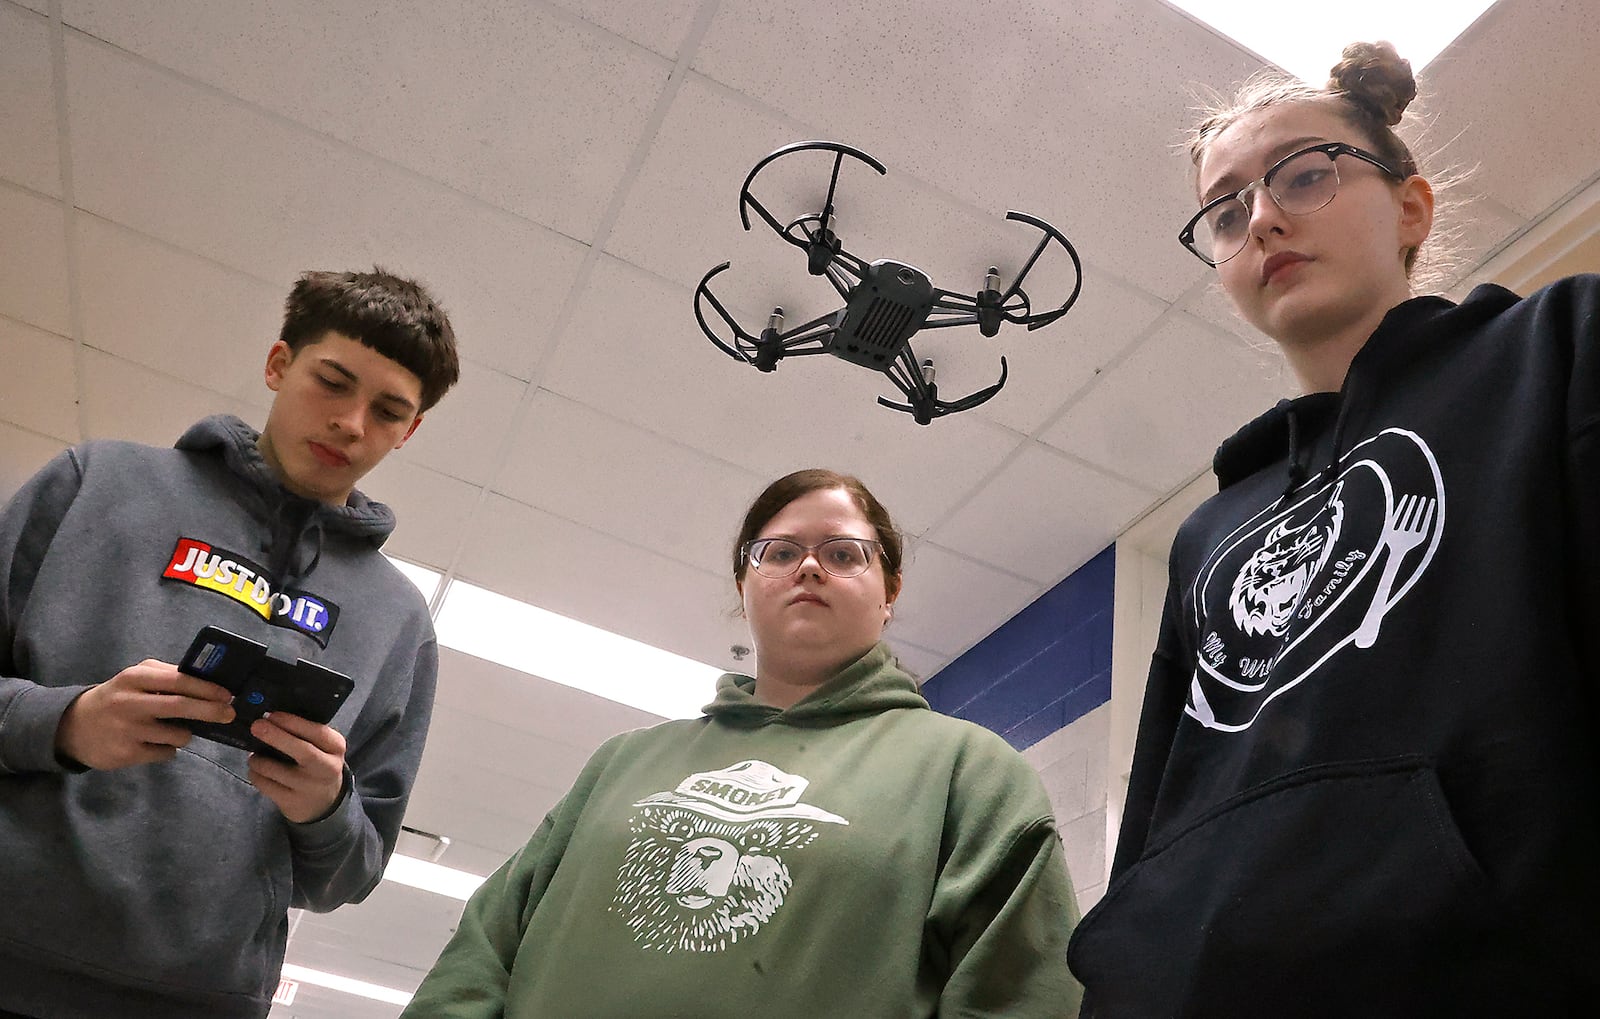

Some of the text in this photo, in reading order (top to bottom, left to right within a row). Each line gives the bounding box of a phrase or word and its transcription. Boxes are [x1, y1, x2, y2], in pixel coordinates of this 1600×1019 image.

[173, 547, 325, 631] JUST DO IT.
[1203, 631, 1228, 669] My
[1297, 549, 1367, 619] Family
[689, 778, 797, 806] SMOKEY
